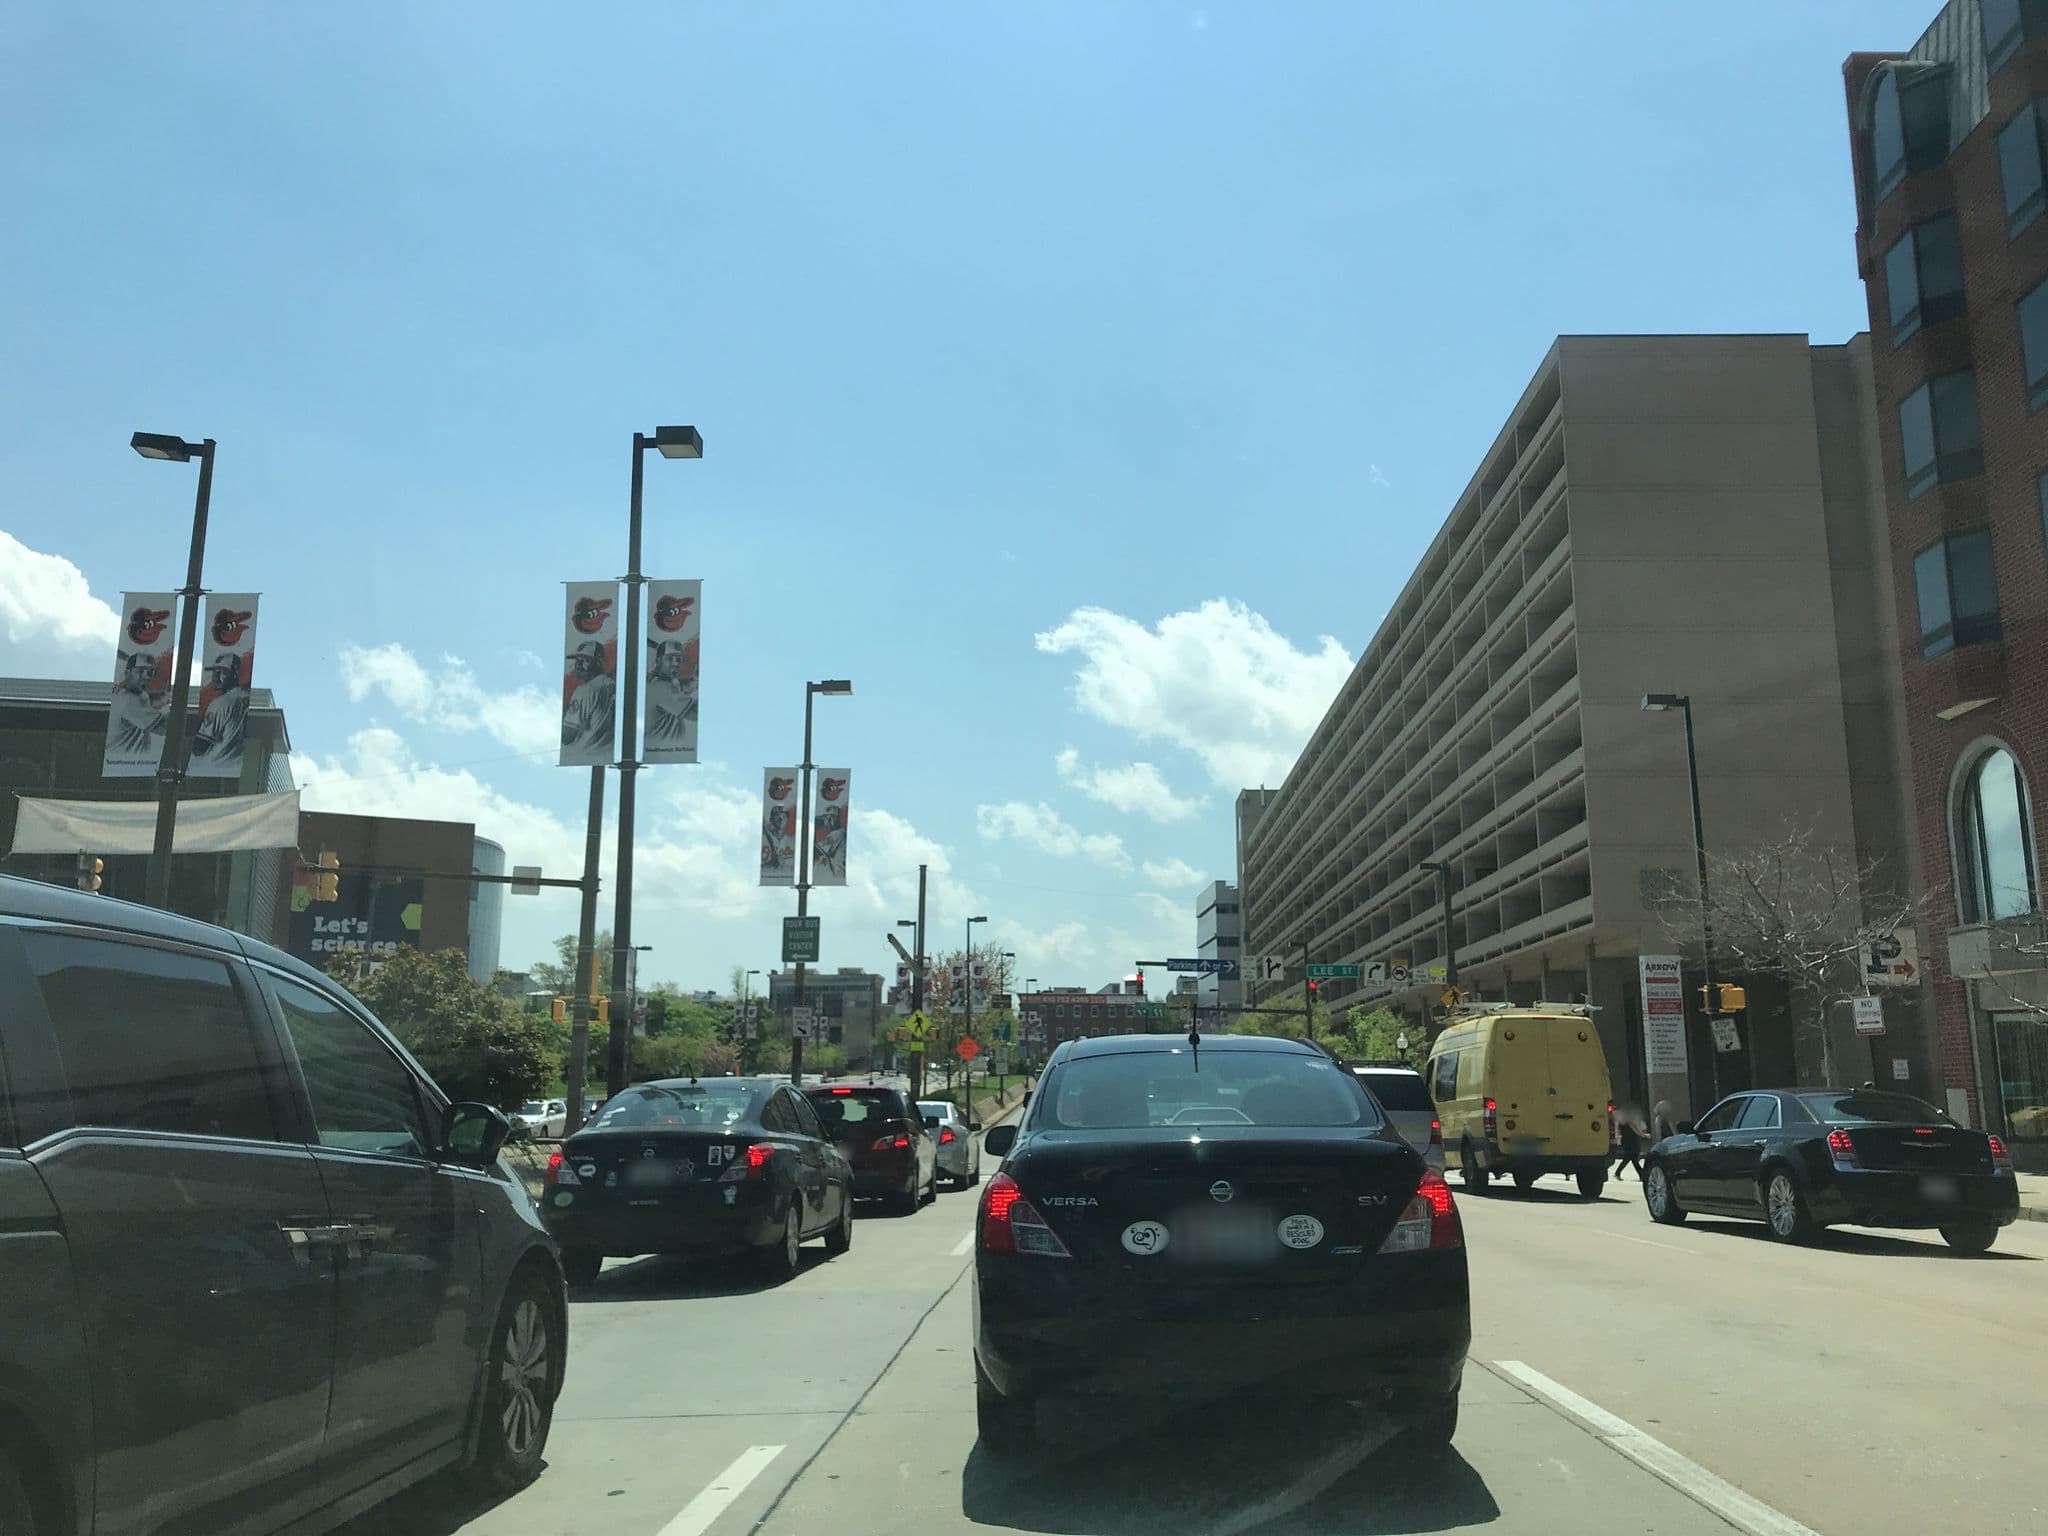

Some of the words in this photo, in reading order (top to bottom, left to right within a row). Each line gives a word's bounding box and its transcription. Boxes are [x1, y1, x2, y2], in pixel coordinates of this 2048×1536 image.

[314, 916, 369, 933] Let's
[1168, 960, 1197, 970] Parking
[1645, 961, 1679, 972] ARROW
[1313, 966, 1334, 976] LEE
[1342, 967, 1352, 975] ST
[1042, 1197, 1099, 1206] VERSA
[1358, 1196, 1387, 1206] SV
